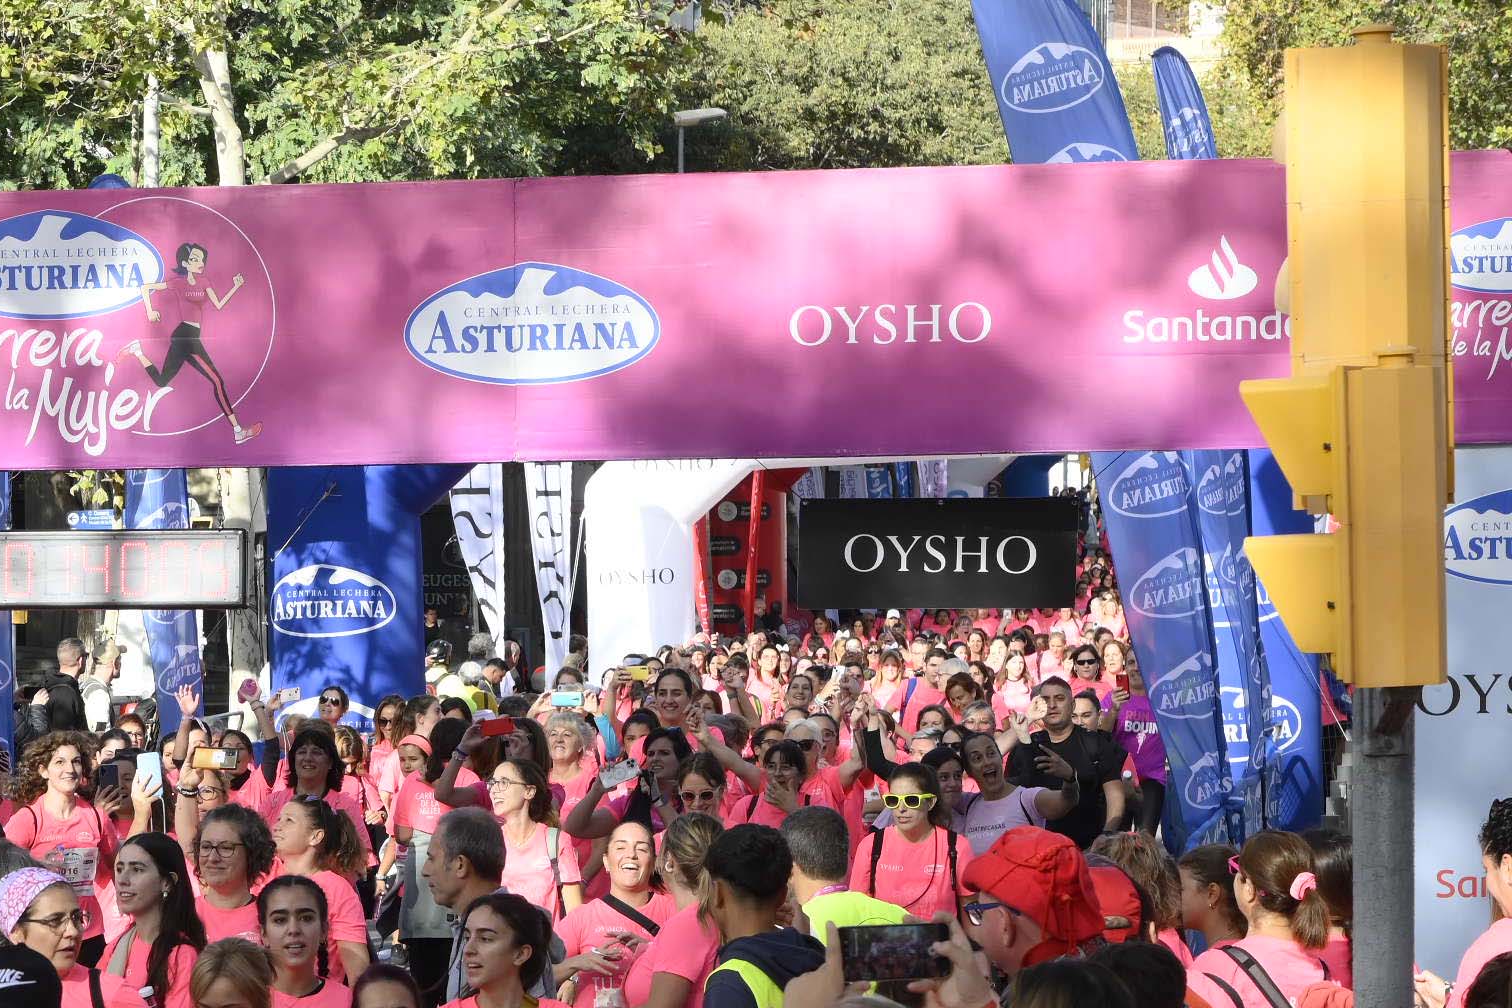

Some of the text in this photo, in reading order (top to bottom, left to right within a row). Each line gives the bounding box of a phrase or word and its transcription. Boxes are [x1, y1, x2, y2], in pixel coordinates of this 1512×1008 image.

[66, 246, 139, 258] LECHERA
[464, 302, 632, 317] CENTRAL LECHERA
[789, 301, 993, 346] OYSHO
[424, 309, 640, 354] ASTURIANA
[1474, 329, 1492, 356] la
[4, 372, 29, 410] la
[25, 358, 174, 456] Mujer
[844, 533, 1038, 575] OYSHO
[286, 589, 329, 598] CENTRAL
[274, 594, 388, 622] ASTURIANA
